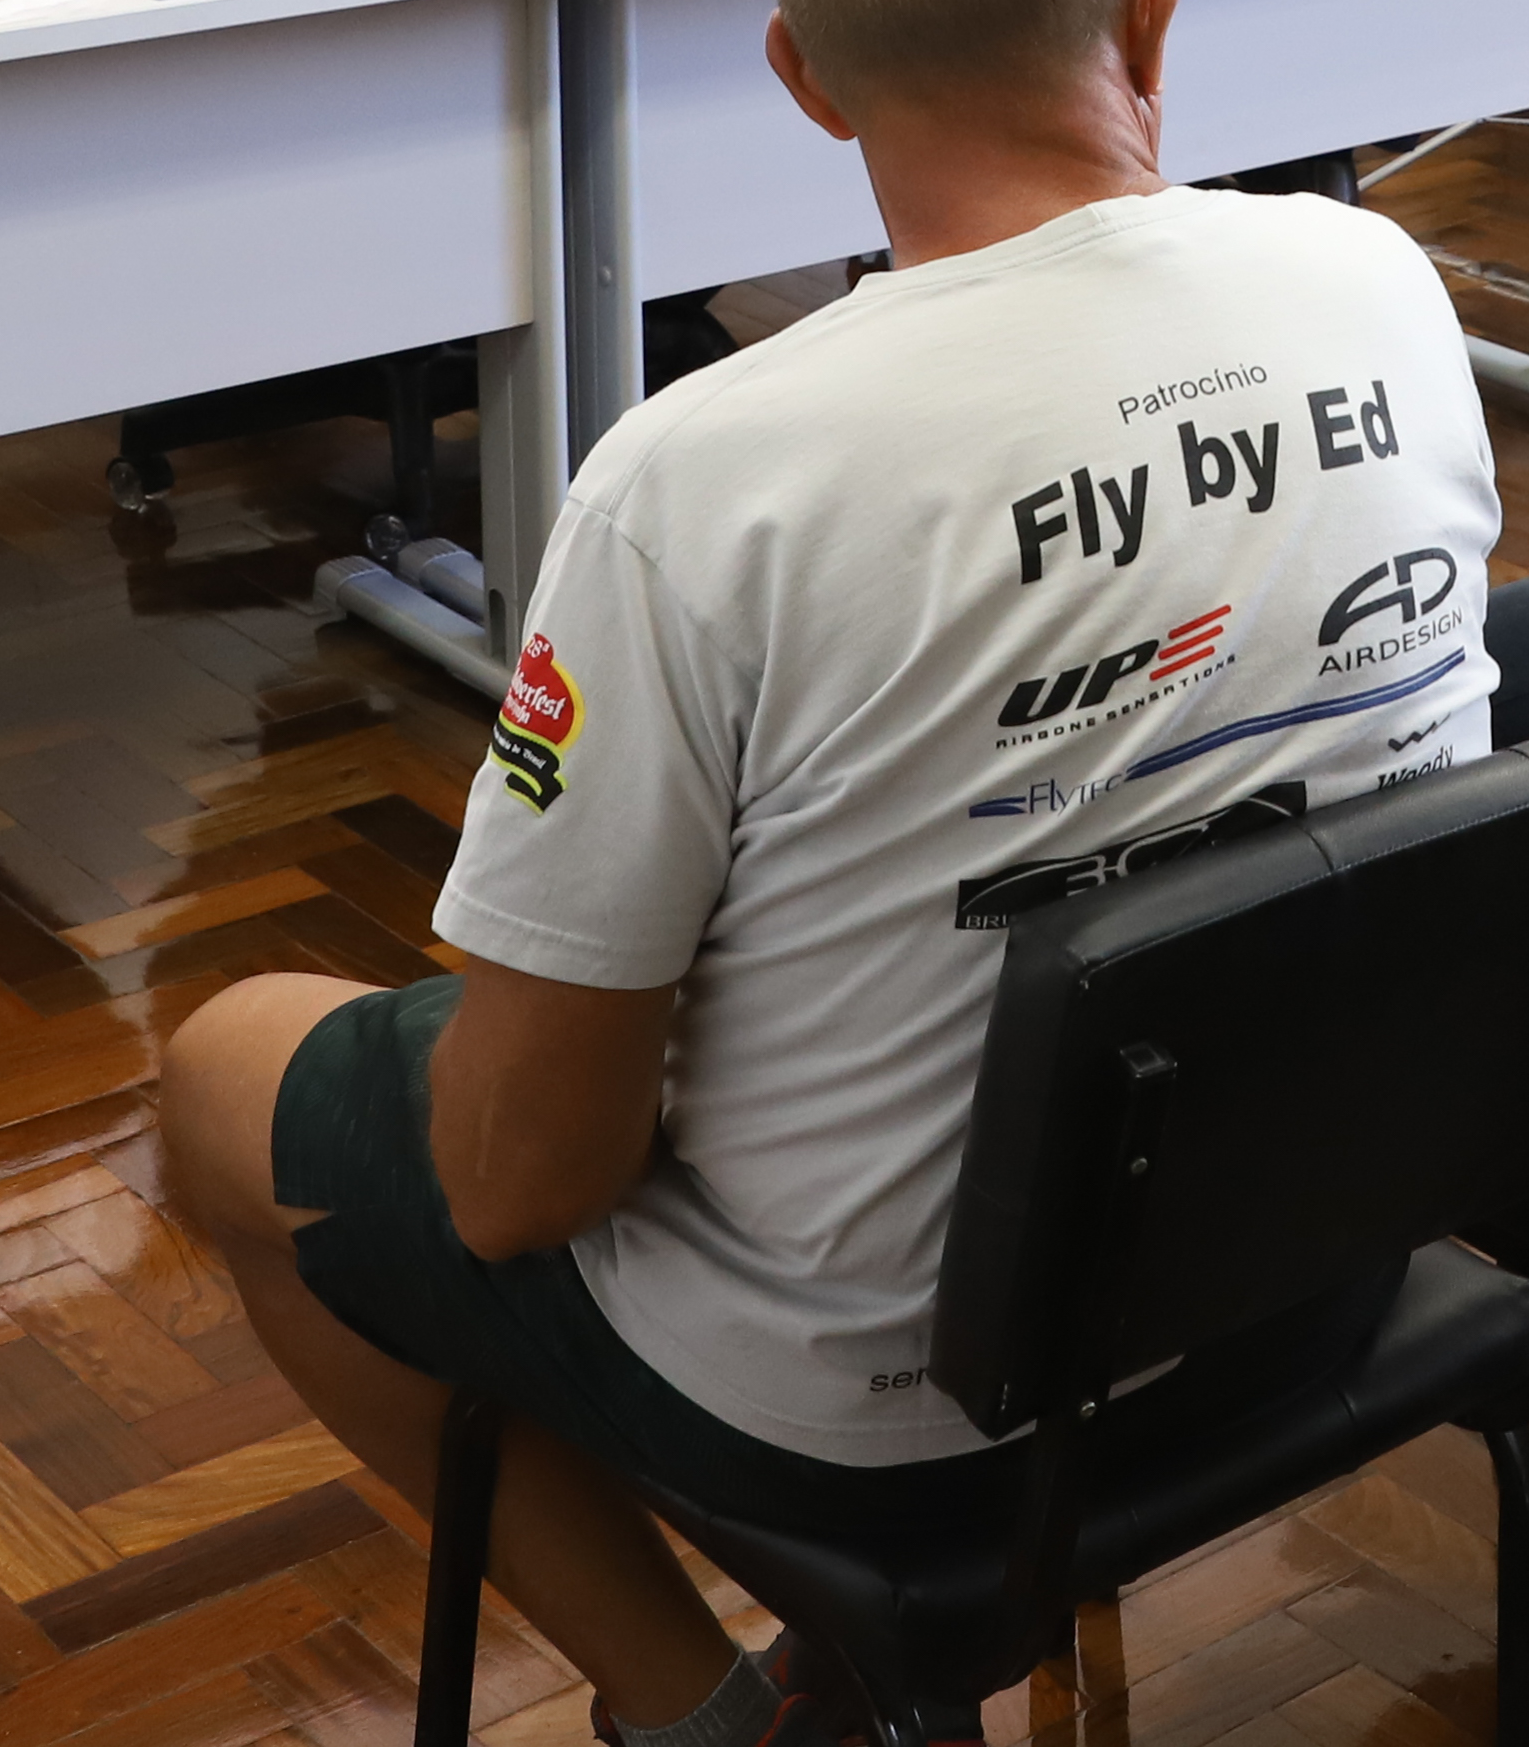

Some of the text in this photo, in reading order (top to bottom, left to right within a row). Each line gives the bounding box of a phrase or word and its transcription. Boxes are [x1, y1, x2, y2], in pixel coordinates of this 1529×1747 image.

[1118, 363, 1268, 425] Patrocínio
[1011, 380, 1400, 585] Fly by Ed
[1318, 606, 1464, 677] AIRDESIGN
[995, 653, 1237, 750] AIRBONE SENSATIONS
